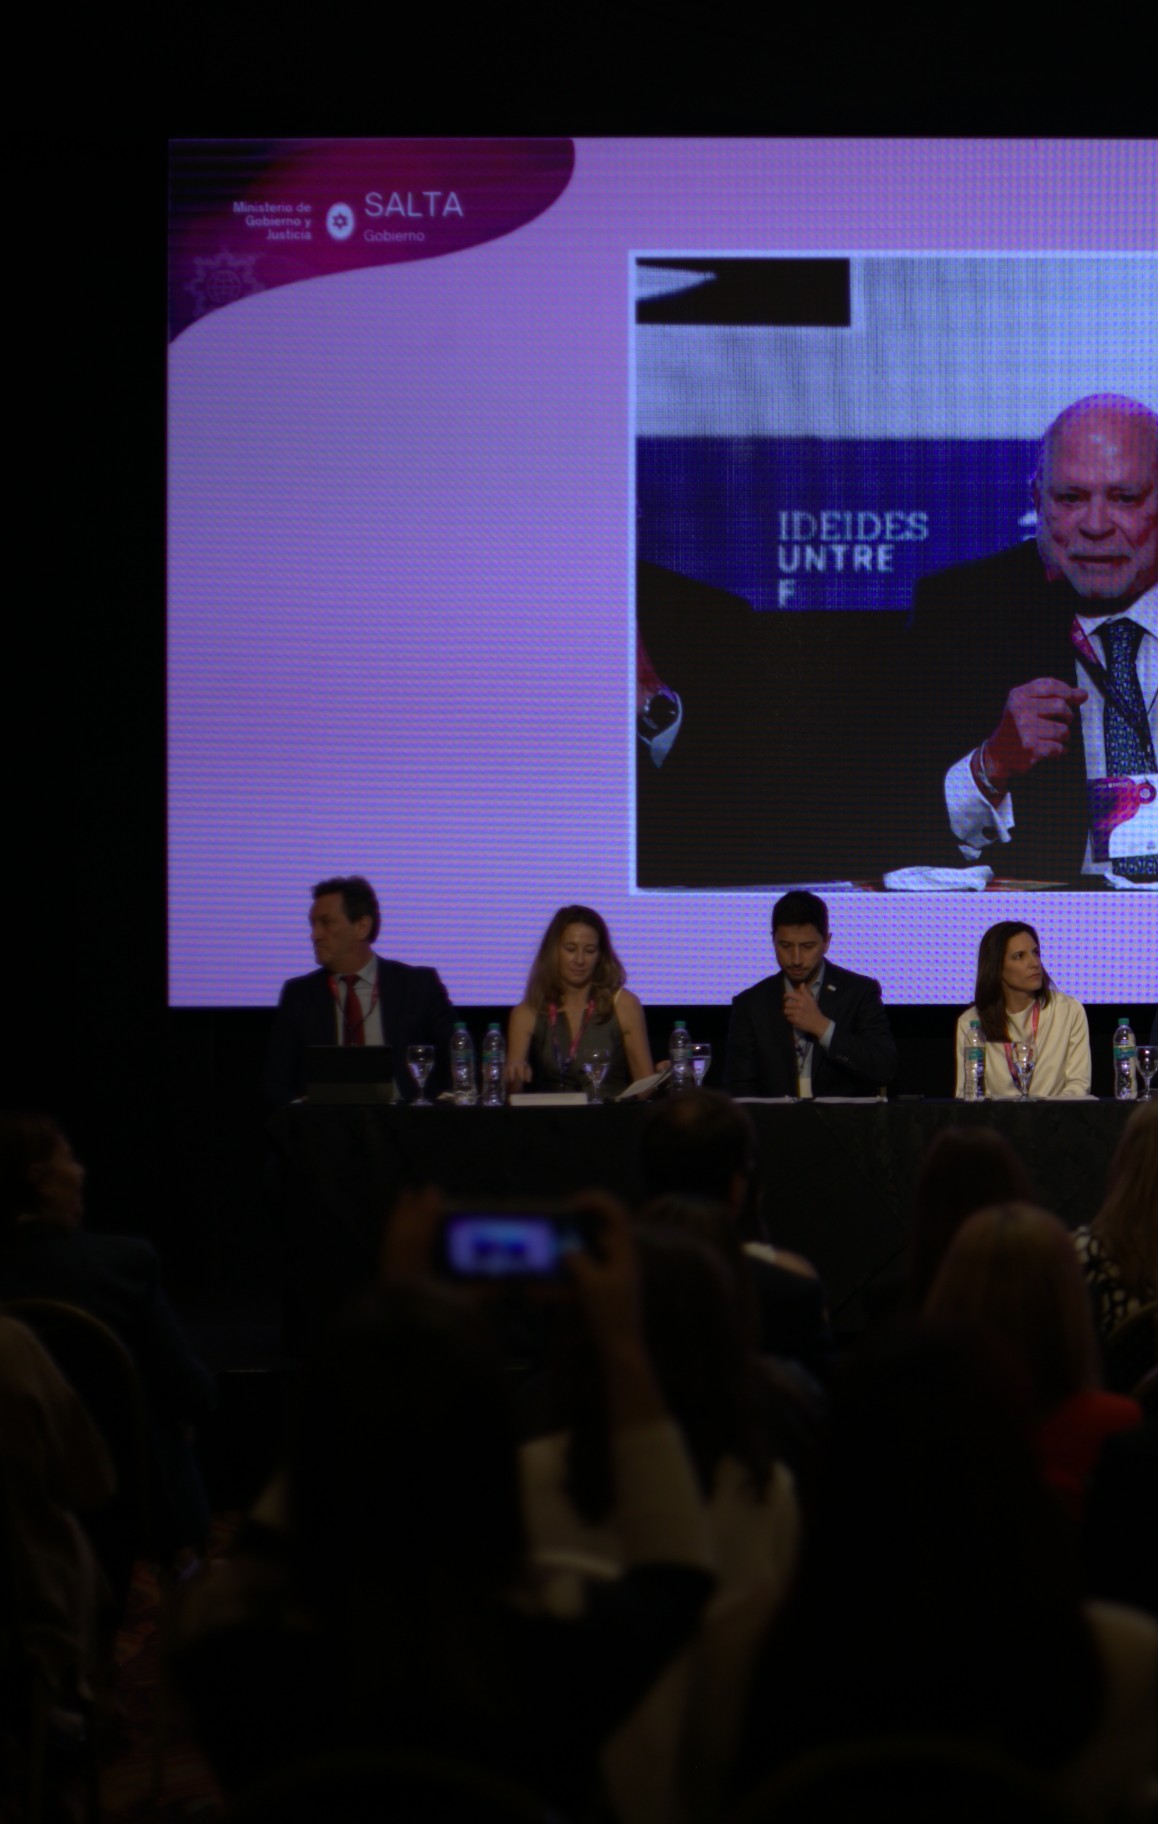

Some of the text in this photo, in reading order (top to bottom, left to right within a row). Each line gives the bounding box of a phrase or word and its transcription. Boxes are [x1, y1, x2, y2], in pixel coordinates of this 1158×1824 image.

[233, 201, 311, 213] Ministerio de
[364, 191, 464, 217] SALTA
[245, 215, 312, 228] Gobierno y
[266, 229, 311, 241] Justicia
[363, 229, 425, 242] Gobierno
[778, 510, 929, 541] IDEIDES
[778, 544, 895, 573] UNTRE
